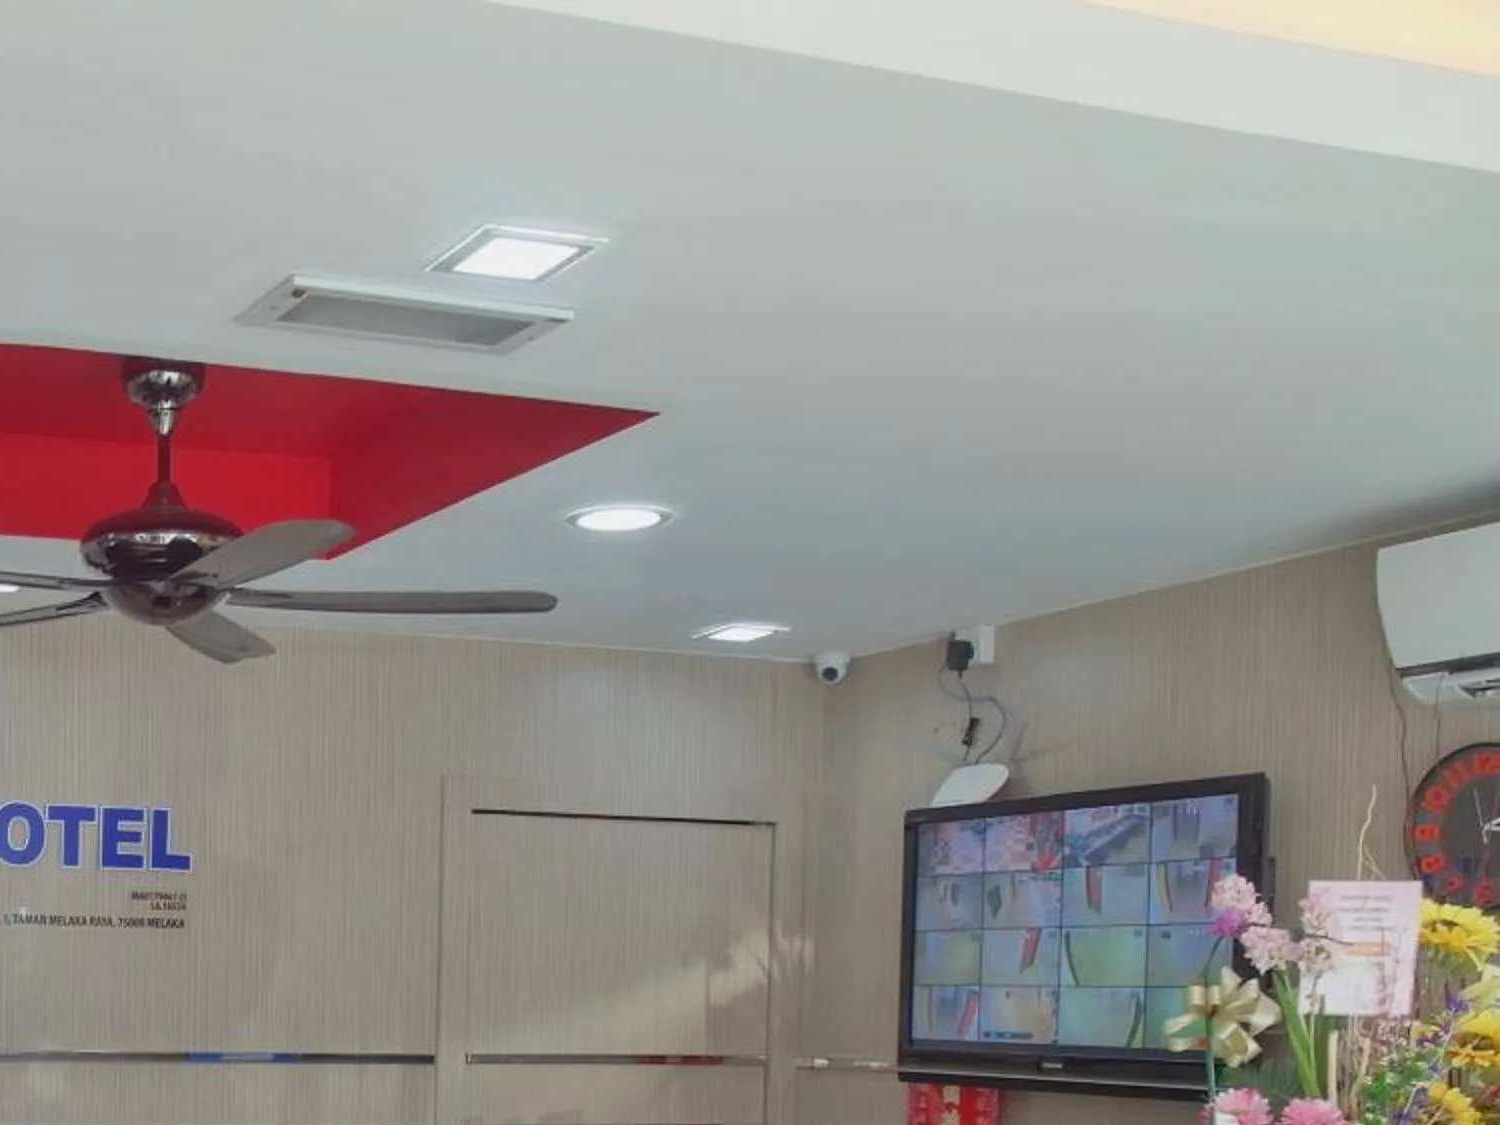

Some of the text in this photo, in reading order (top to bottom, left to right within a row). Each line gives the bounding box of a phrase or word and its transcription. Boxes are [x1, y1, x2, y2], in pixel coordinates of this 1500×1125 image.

[13, 913, 46, 925] TAMAN
[49, 914, 87, 927] MELAKA
[147, 917, 185, 929] MELAKA
